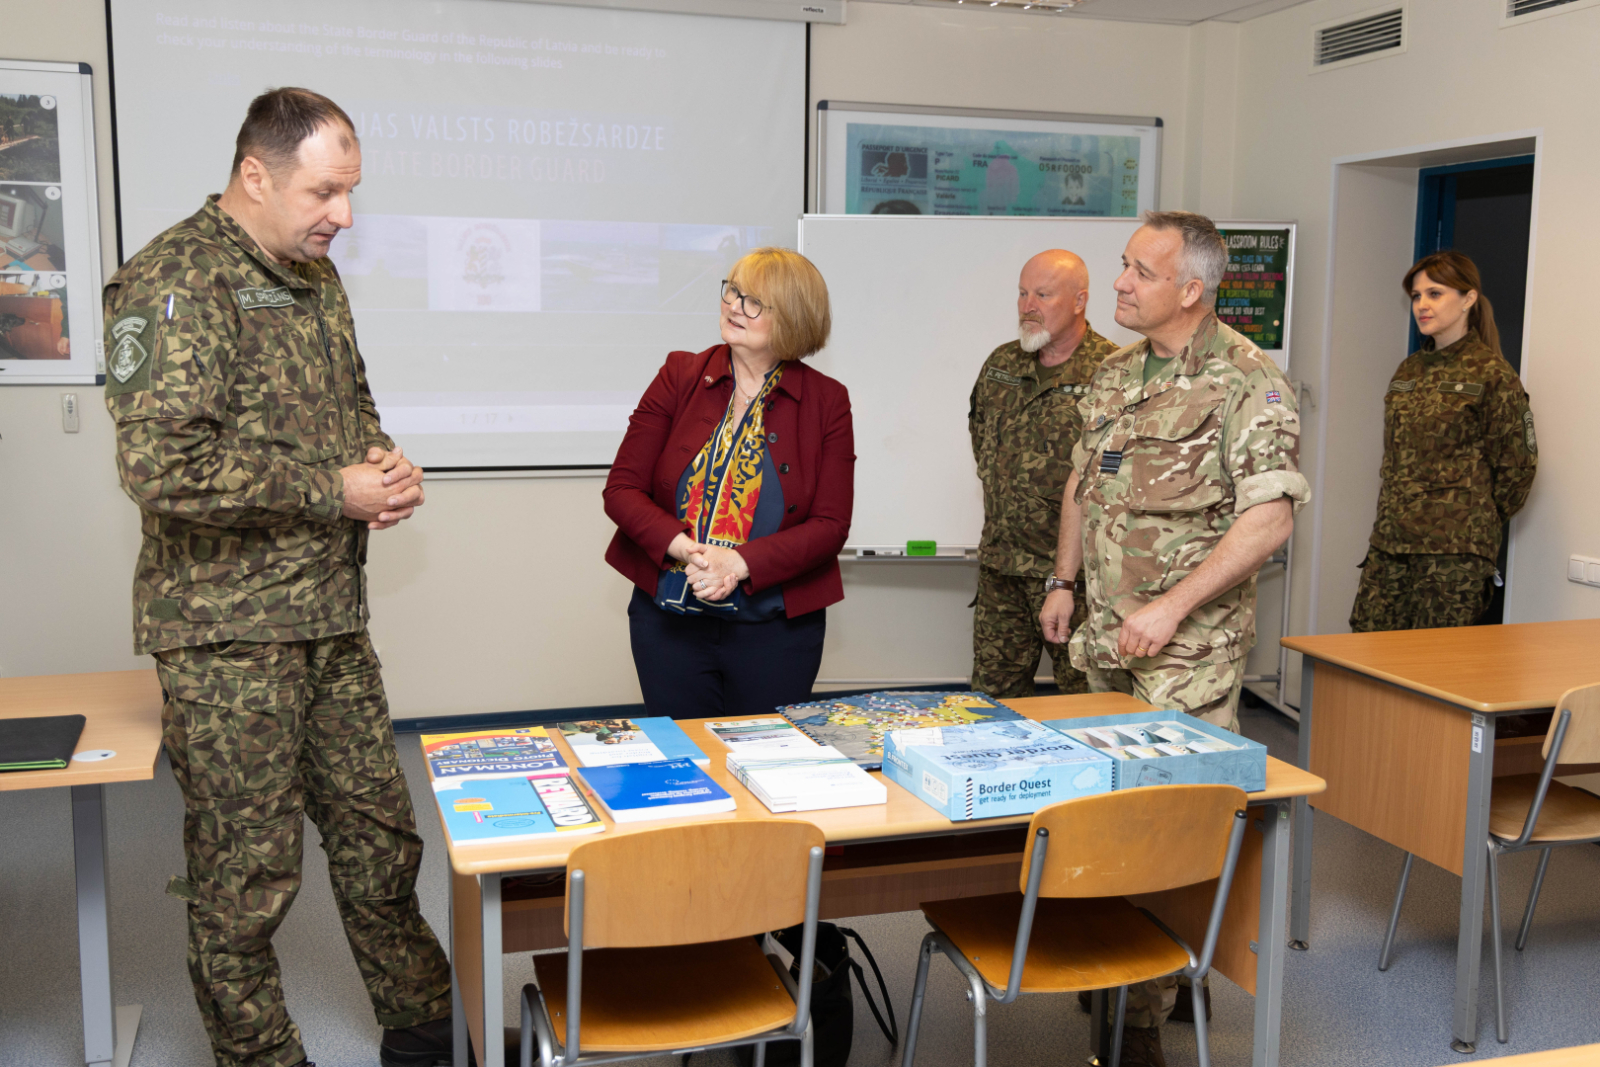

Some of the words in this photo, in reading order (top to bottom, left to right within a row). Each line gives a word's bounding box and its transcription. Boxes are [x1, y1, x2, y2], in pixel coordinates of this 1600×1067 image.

[156, 12, 188, 27] Read
[192, 16, 216, 28] and
[220, 17, 254, 31] listen
[258, 20, 295, 34] about
[298, 23, 319, 36] the
[322, 24, 353, 38] State
[356, 26, 397, 41] Border
[402, 29, 438, 43] Guard
[441, 32, 454, 44] of
[457, 32, 476, 46] the
[479, 34, 528, 50] Republic
[530, 38, 543, 50] of
[545, 39, 577, 52] Latvia
[581, 42, 602, 54] and
[604, 42, 619, 55] be
[621, 45, 652, 60] ready
[654, 47, 667, 59] to
[156, 32, 194, 46] check
[197, 37, 226, 51] your
[231, 37, 321, 58] understanding
[325, 42, 339, 55] of
[341, 44, 360, 56] the
[364, 46, 435, 64] terminology
[439, 51, 451, 62] in
[453, 51, 473, 63] the
[476, 53, 529, 70] following
[530, 57, 563, 69] slides
[410, 113, 495, 142] VALSTS
[508, 117, 665, 151] ROBEŽSARDZE
[861, 144, 894, 152] PASSEPORT
[361, 149, 422, 177] TATE
[430, 152, 520, 178] BORDER
[530, 156, 606, 183] GUARD
[973, 160, 988, 168] FRA
[1039, 162, 1093, 174] 05RF00000
[935, 174, 960, 182] PICARD
[1225, 234, 1258, 249] LASSROOM
[1259, 235, 1279, 249] RULES
[240, 294, 255, 304] M.
[1254, 307, 1266, 316] BEST
[485, 412, 498, 425] 17
[1006, 744, 1075, 755] Border
[436, 756, 509, 767] DICTIONARY
[513, 752, 555, 761] PHOTO
[891, 753, 909, 771] FRONTEX
[940, 751, 1003, 761] Quest
[439, 760, 560, 775] LONGMAN
[979, 782, 1017, 795] Border
[1019, 778, 1052, 792] Quest
[979, 796, 990, 805] get
[990, 794, 1007, 802] ready
[1008, 792, 1017, 801] for
[1018, 790, 1052, 800] deployment
